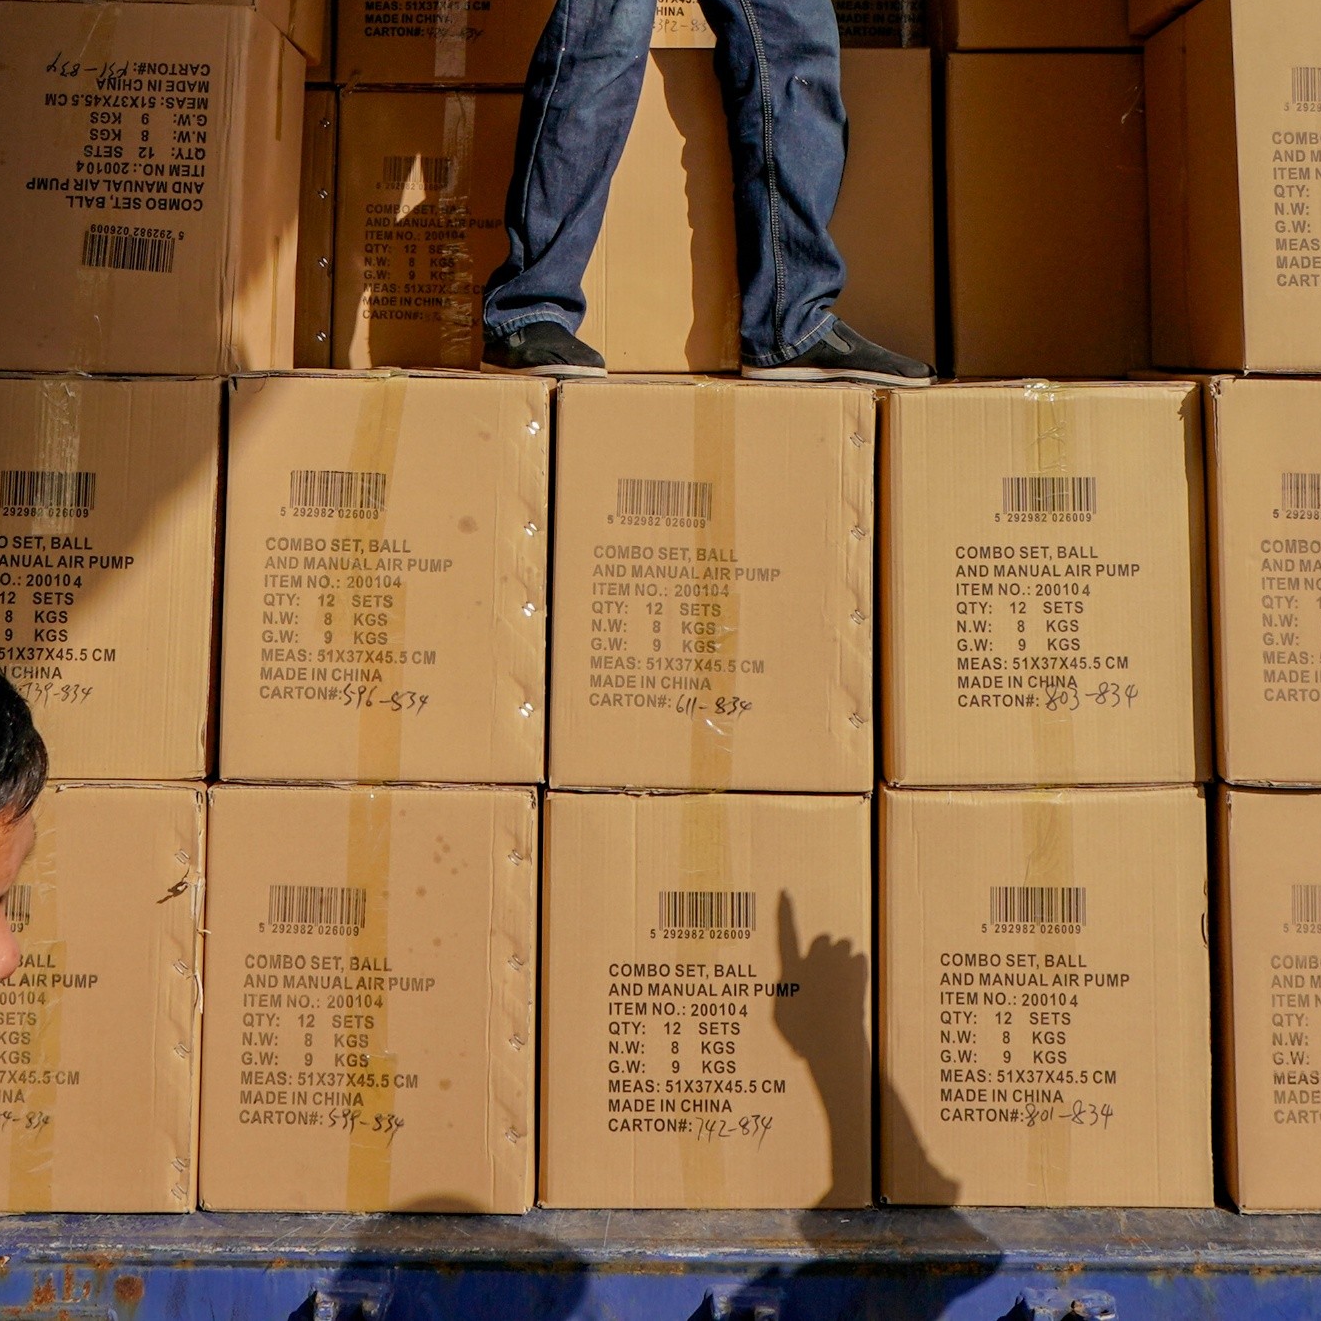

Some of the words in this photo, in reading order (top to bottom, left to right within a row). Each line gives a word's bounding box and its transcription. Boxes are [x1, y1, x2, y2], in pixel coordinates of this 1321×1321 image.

[656, 6, 684, 17] HINA
[131, 61, 210, 75] CARTON#:
[1272, 150, 1306, 162] AND
[25, 176, 69, 189] PUMP
[72, 178, 99, 190] AIR
[101, 178, 167, 192] MANUAL
[171, 180, 204, 193] AND
[64, 194, 105, 207] BALL
[144, 197, 203, 210] COMBO
[1007, 513, 1047, 523] 292982
[1052, 513, 1092, 523] 026009
[51, 537, 93, 551] BALL
[593, 545, 654, 560] COMBO
[696, 548, 739, 562] BALL
[955, 545, 1015, 559] COMBO
[1057, 546, 1099, 559] BALL
[955, 583, 994, 597] ITEM
[998, 582, 1031, 596] NO.:
[1035, 582, 1091, 597] 200104
[32, 591, 74, 605] SETS
[261, 630, 299, 644] G.W:
[324, 631, 333, 644] 9
[354, 631, 388, 645] KGS
[590, 656, 641, 670] MEAS:
[646, 657, 737, 672] 51X37X45.5
[740, 659, 765, 673] CM
[1263, 669, 1310, 683] MADE
[259, 686, 343, 701] CARTON#:
[957, 694, 1040, 708] CARTON#:
[1045, 681, 1138, 711] 803-834
[589, 693, 672, 709] CARTON#:
[675, 694, 752, 721] 611-834
[663, 929, 705, 939] 292982
[709, 930, 751, 940] 026009
[608, 963, 671, 977] COMBO
[714, 964, 757, 978] BALL
[939, 972, 974, 986] AND
[979, 972, 1049, 987] MANUAL
[1051, 973, 1079, 987] AIR
[1084, 974, 1130, 988] PUMP
[608, 983, 643, 997] AND
[648, 983, 718, 997] MANUAL
[721, 983, 749, 997] AIR
[753, 983, 800, 997] PUMP
[1271, 994, 1310, 1008] ITEM
[940, 1011, 977, 1025] QTY:
[995, 1011, 1012, 1025] 12
[1029, 1011, 1071, 1026] SETS
[55, 1070, 81, 1085] CM
[239, 1110, 324, 1126] CARTON#:
[940, 1108, 1024, 1123] CARTON#:
[1026, 1100, 1114, 1130] 801-834
[608, 1118, 693, 1133] CARTON#:
[695, 1114, 773, 1154] 742-834
